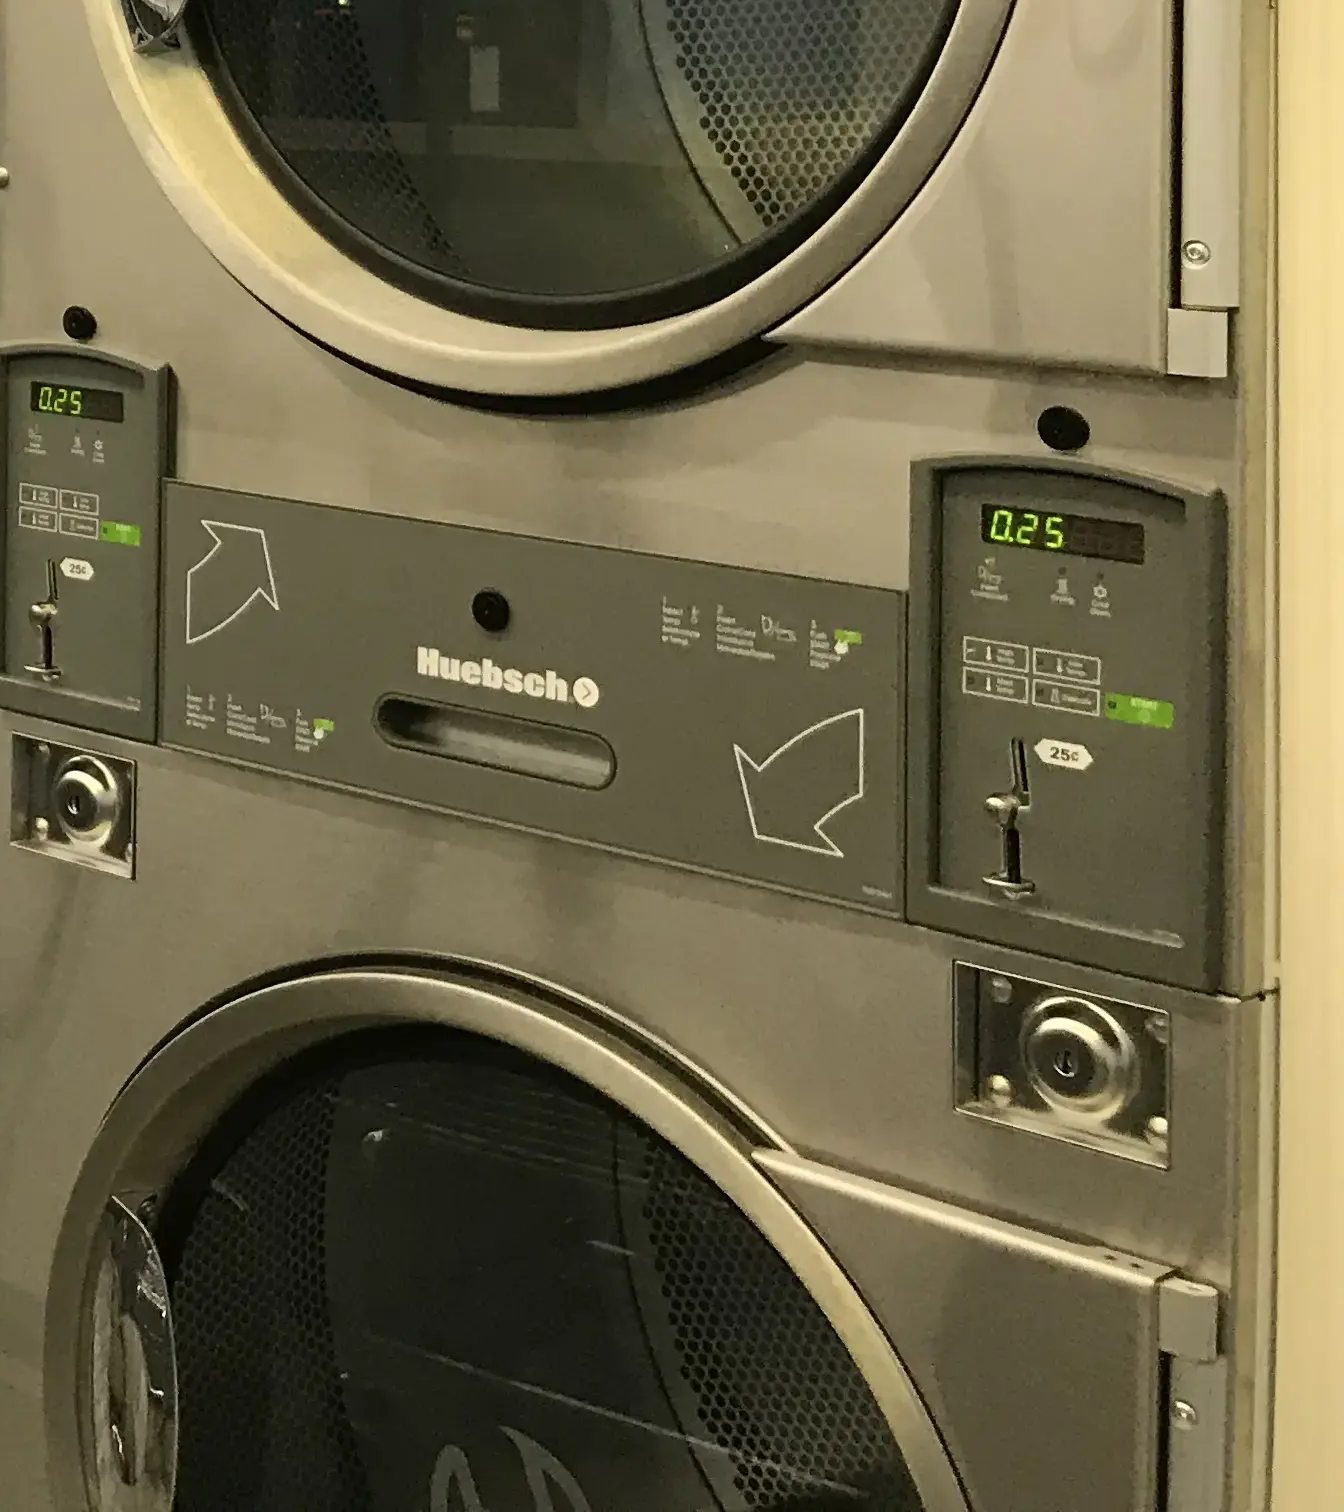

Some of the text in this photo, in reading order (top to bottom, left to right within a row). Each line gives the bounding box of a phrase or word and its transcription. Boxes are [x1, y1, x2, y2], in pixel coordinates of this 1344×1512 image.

[38, 386, 82, 415] 0.25
[990, 509, 1064, 549] 0.25
[417, 646, 568, 703] Huebsch
[1050, 746, 1079, 762] 25¢
